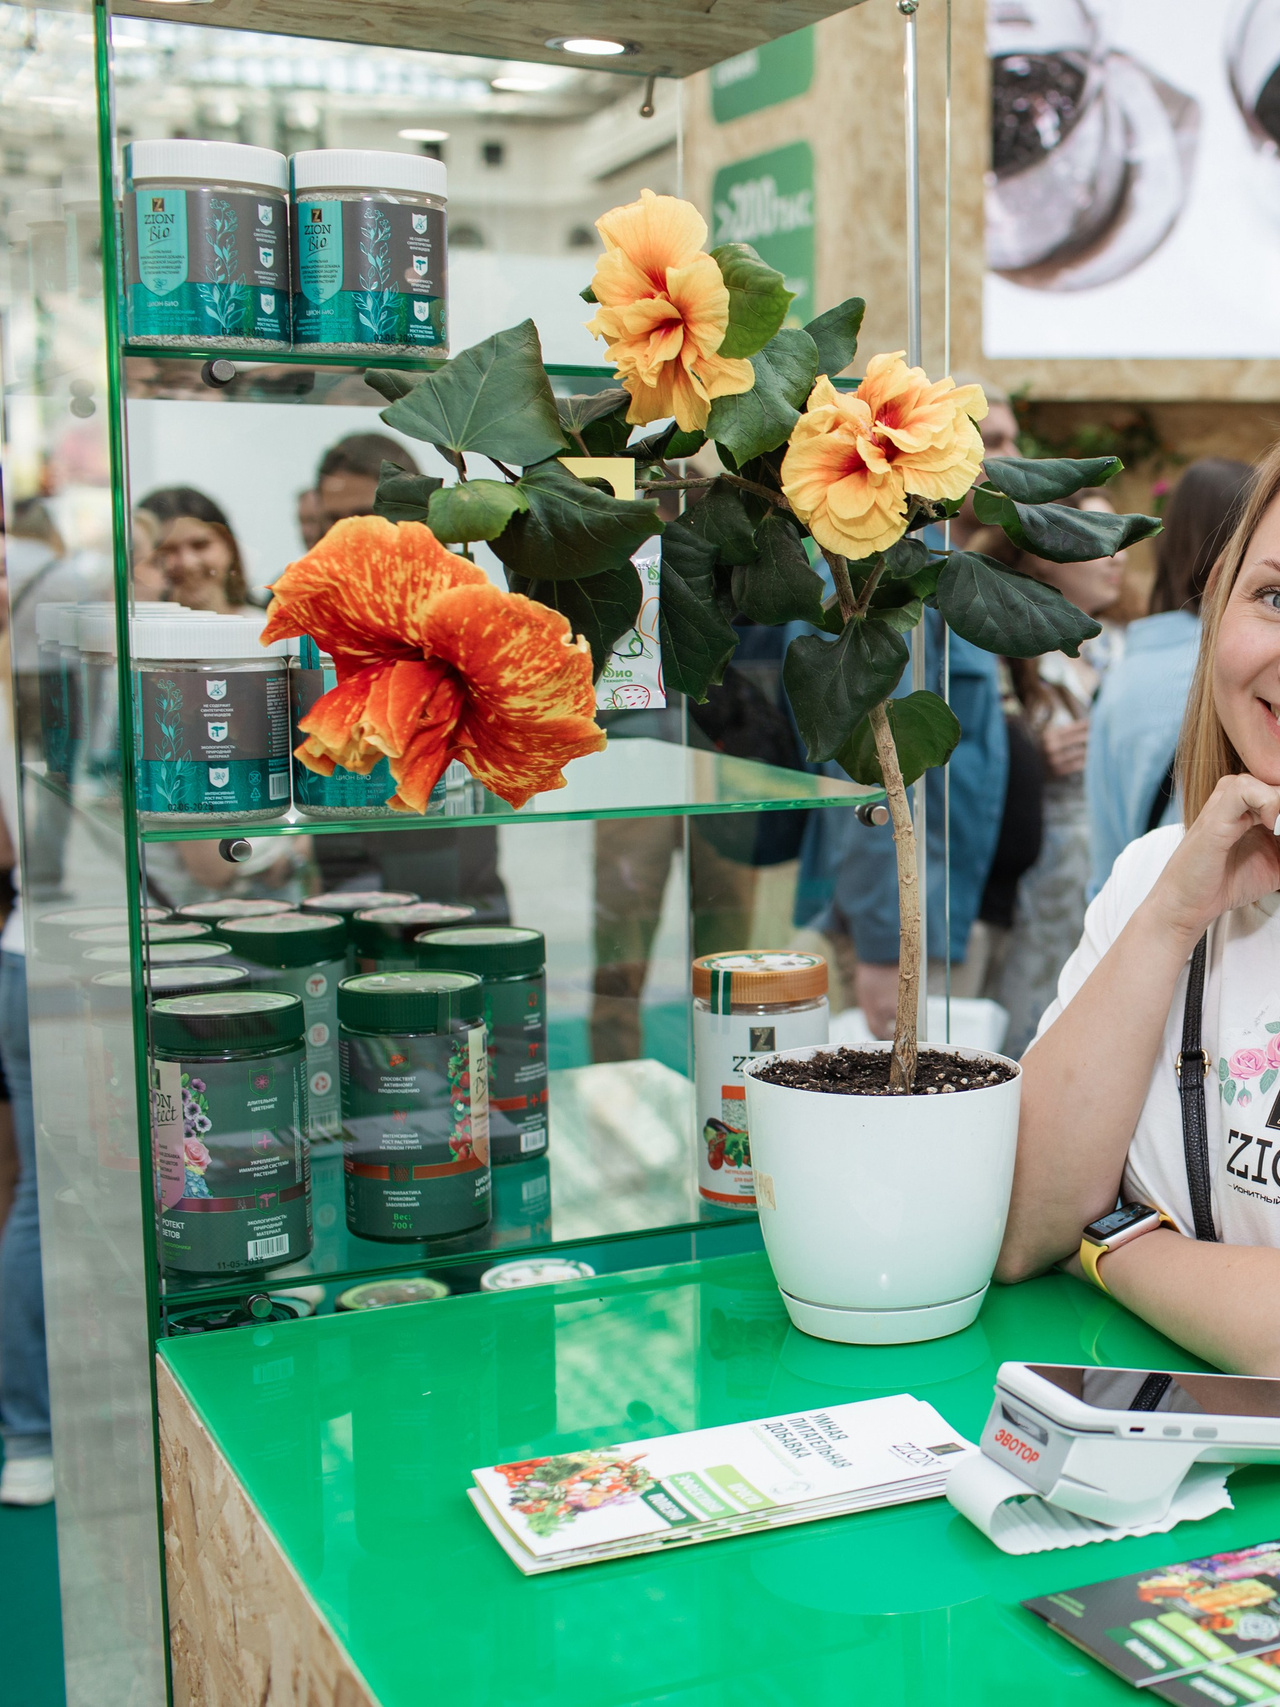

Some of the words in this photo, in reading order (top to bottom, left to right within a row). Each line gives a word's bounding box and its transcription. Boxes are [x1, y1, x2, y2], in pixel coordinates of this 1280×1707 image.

[144, 213, 175, 225] ZION
[148, 225, 170, 242] Bio
[304, 224, 332, 235] ZION
[308, 235, 327, 252] Bio
[374, 333, 417, 343] 02-06-2025
[247, 1096, 278, 1107] ДЛИТЕЛЬНОЕ
[250, 1103, 275, 1113] ЦВЕТЕНИЕ
[238, 1163, 269, 1174] ИММУННОЙ
[268, 1160, 290, 1170] СИСТЕМЫ
[250, 1156, 281, 1166] УКРЕПЛЕНИЕ
[253, 1169, 278, 1179] РАСТЕНИЙ
[246, 1214, 287, 1226] ЭКОЛОГИЧНОСТЬ
[393, 1212, 411, 1221] Вес:
[253, 1221, 283, 1231] ПРИРОДНЫЙ
[392, 1221, 408, 1230] 700
[256, 1227, 281, 1238] МАТЕРИАЛ
[217, 1256, 264, 1270] 11-05-2025
[809, 1412, 849, 1441] УМНАЯ
[760, 1422, 812, 1459] ДОБАВКА
[787, 1417, 854, 1469] ПИТАТЕЛЬНАЯ
[994, 1428, 1041, 1465] ЭВОТОР
[891, 1442, 942, 1467] ZION
[647, 1492, 688, 1521] ПОЛЕЗНО
